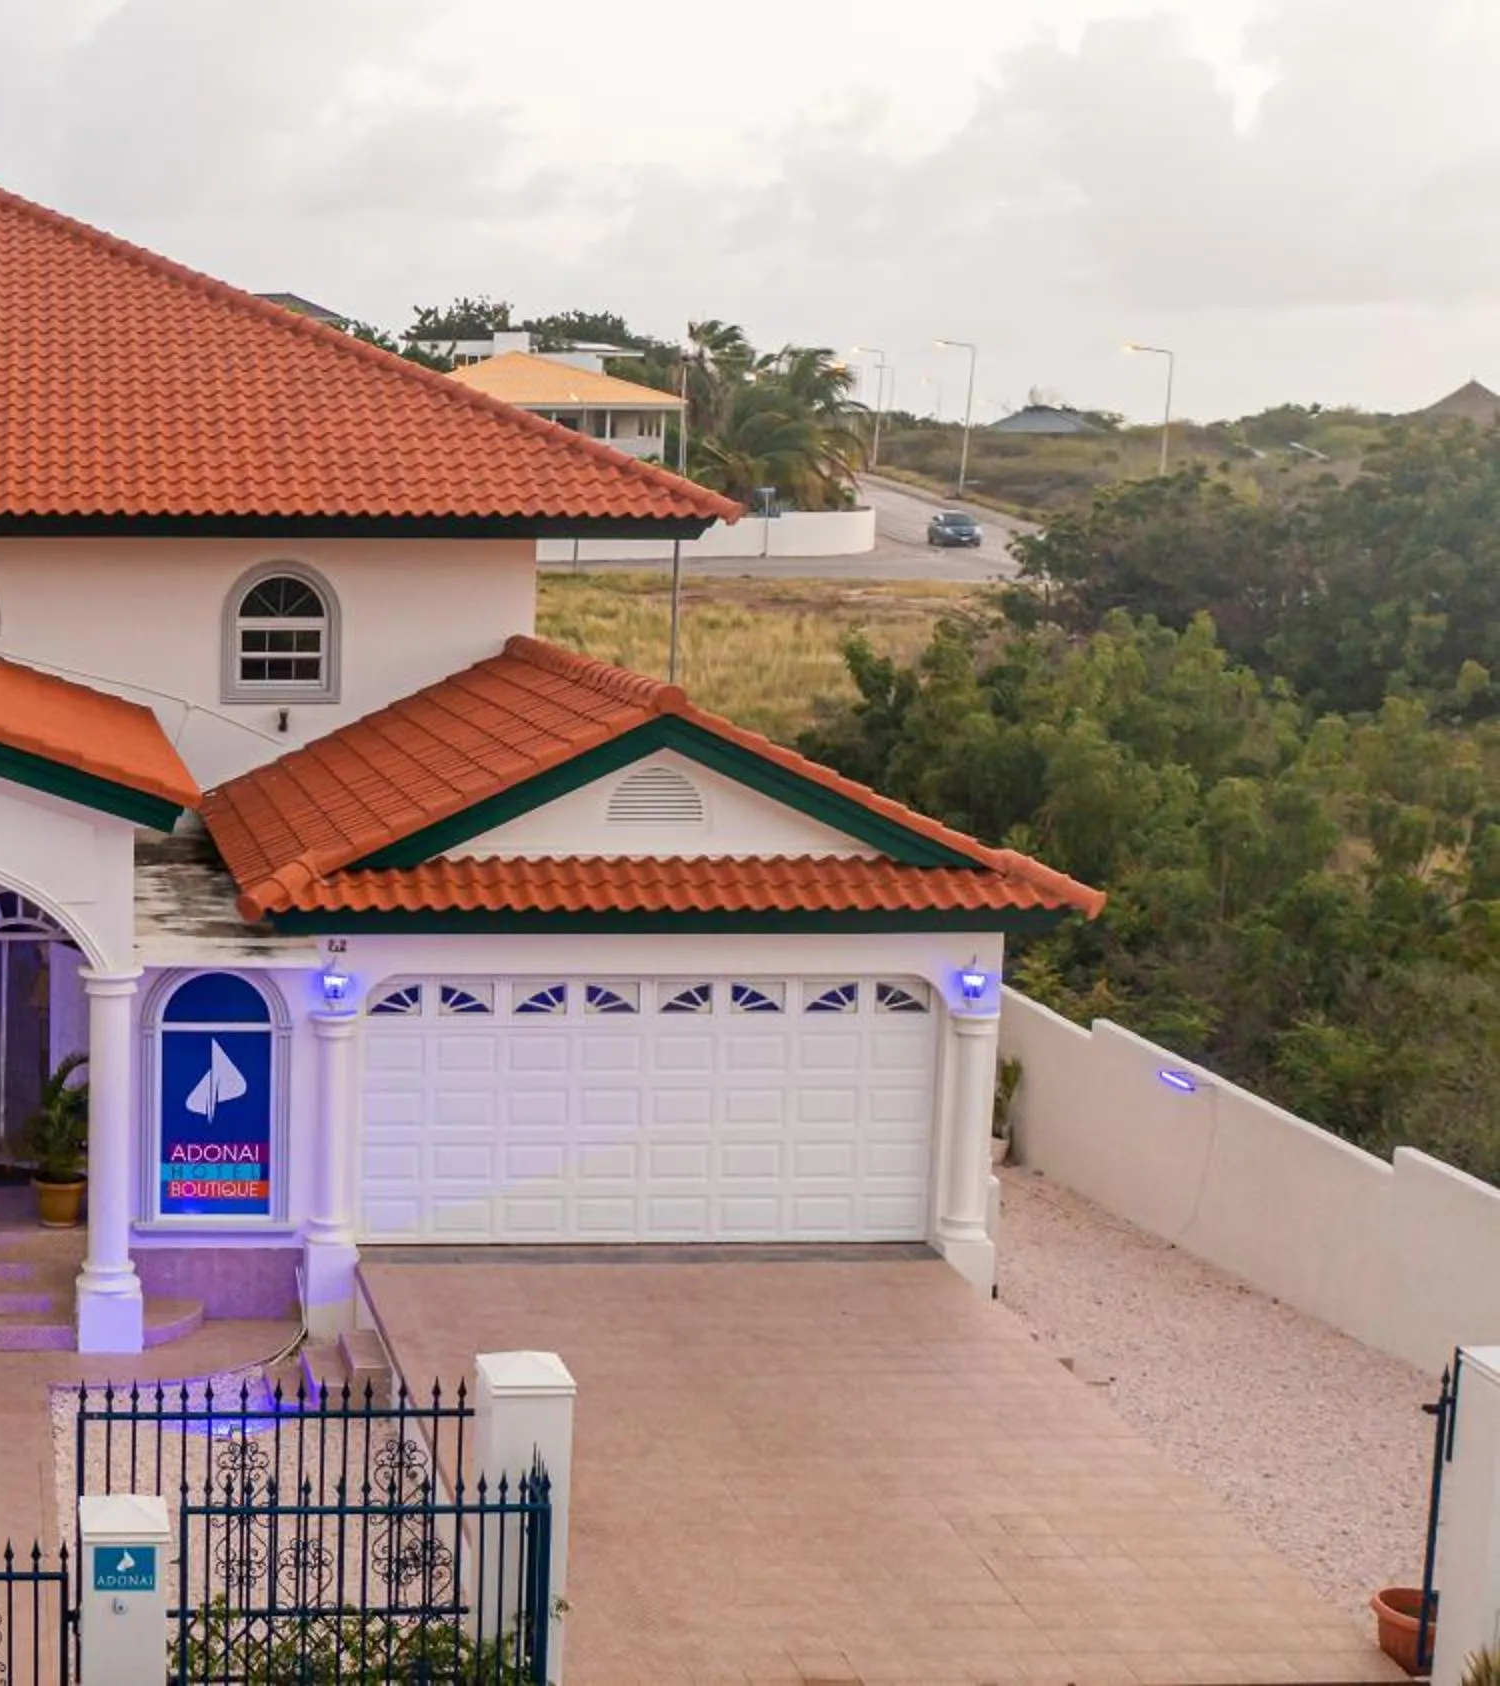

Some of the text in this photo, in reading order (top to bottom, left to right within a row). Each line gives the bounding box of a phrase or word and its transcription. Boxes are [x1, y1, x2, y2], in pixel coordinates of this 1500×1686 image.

[171, 1143, 259, 1162] ADONAI
[171, 1165, 260, 1180] HOTEL
[170, 1181, 259, 1197] BOUTIQUE
[97, 1575, 153, 1585] ADONAI
